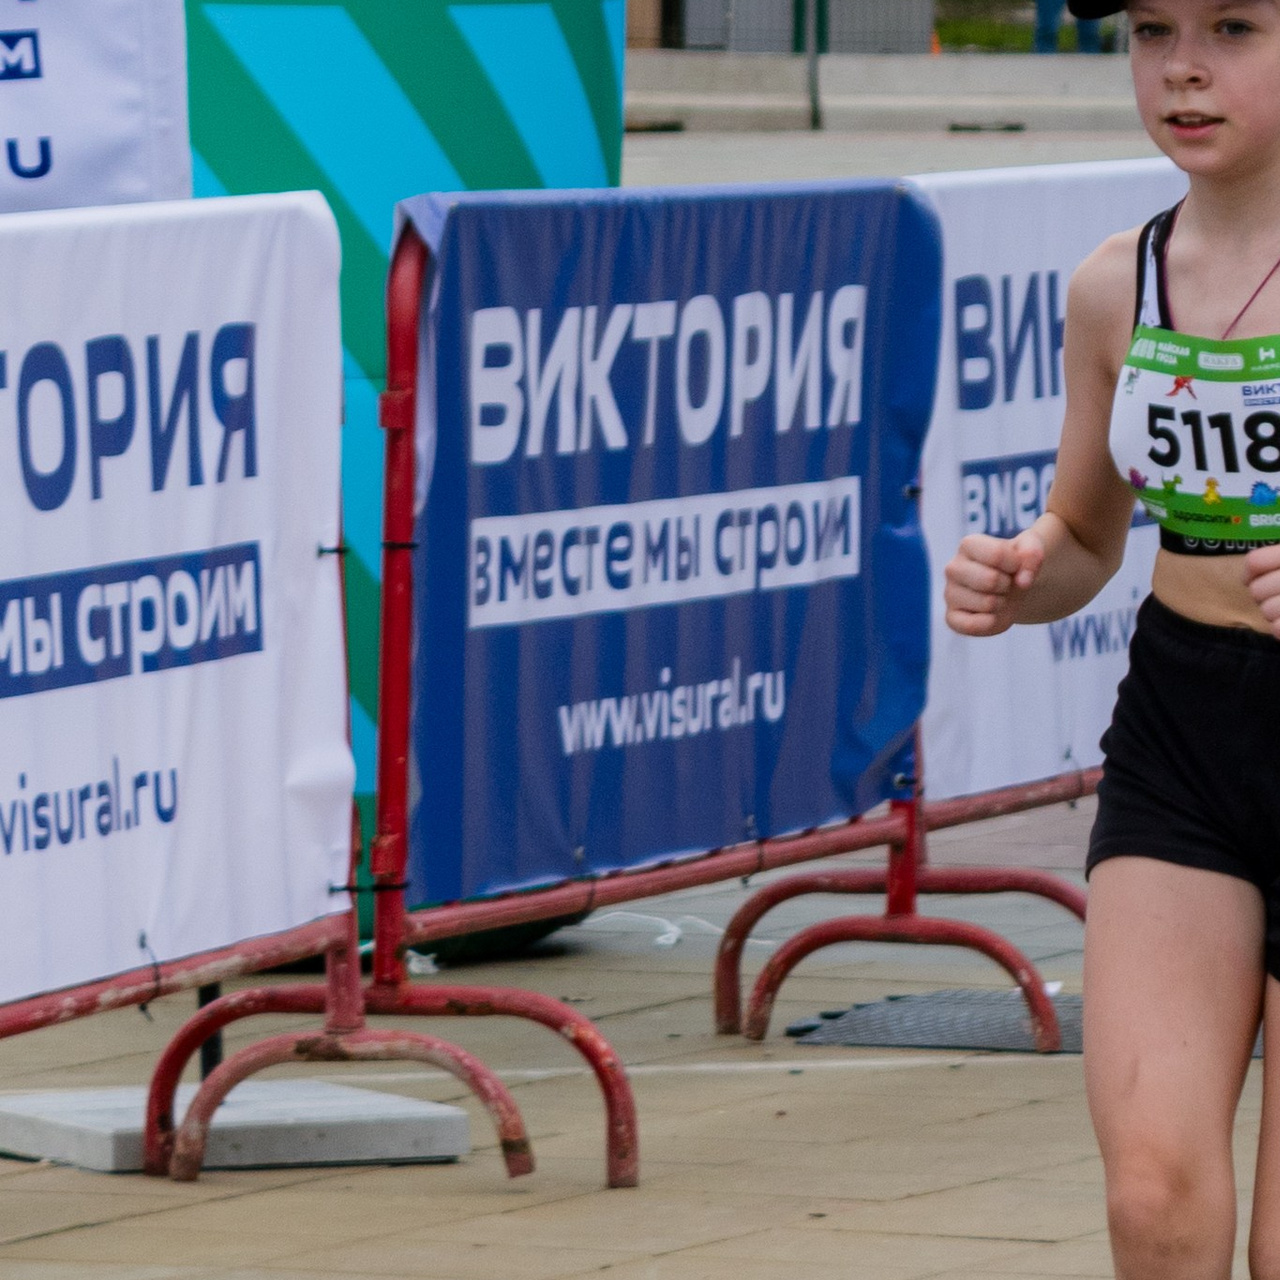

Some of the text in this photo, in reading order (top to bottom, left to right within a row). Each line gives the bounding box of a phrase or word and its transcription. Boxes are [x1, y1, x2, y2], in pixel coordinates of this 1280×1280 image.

[0, 321, 258, 513] ОРИЯ
[471, 284, 868, 466] ВИКТОРИЯ
[475, 493, 852, 607] вместе мы строим
[76, 559, 258, 676] строим
[557, 656, 786, 757] www.visural.ru
